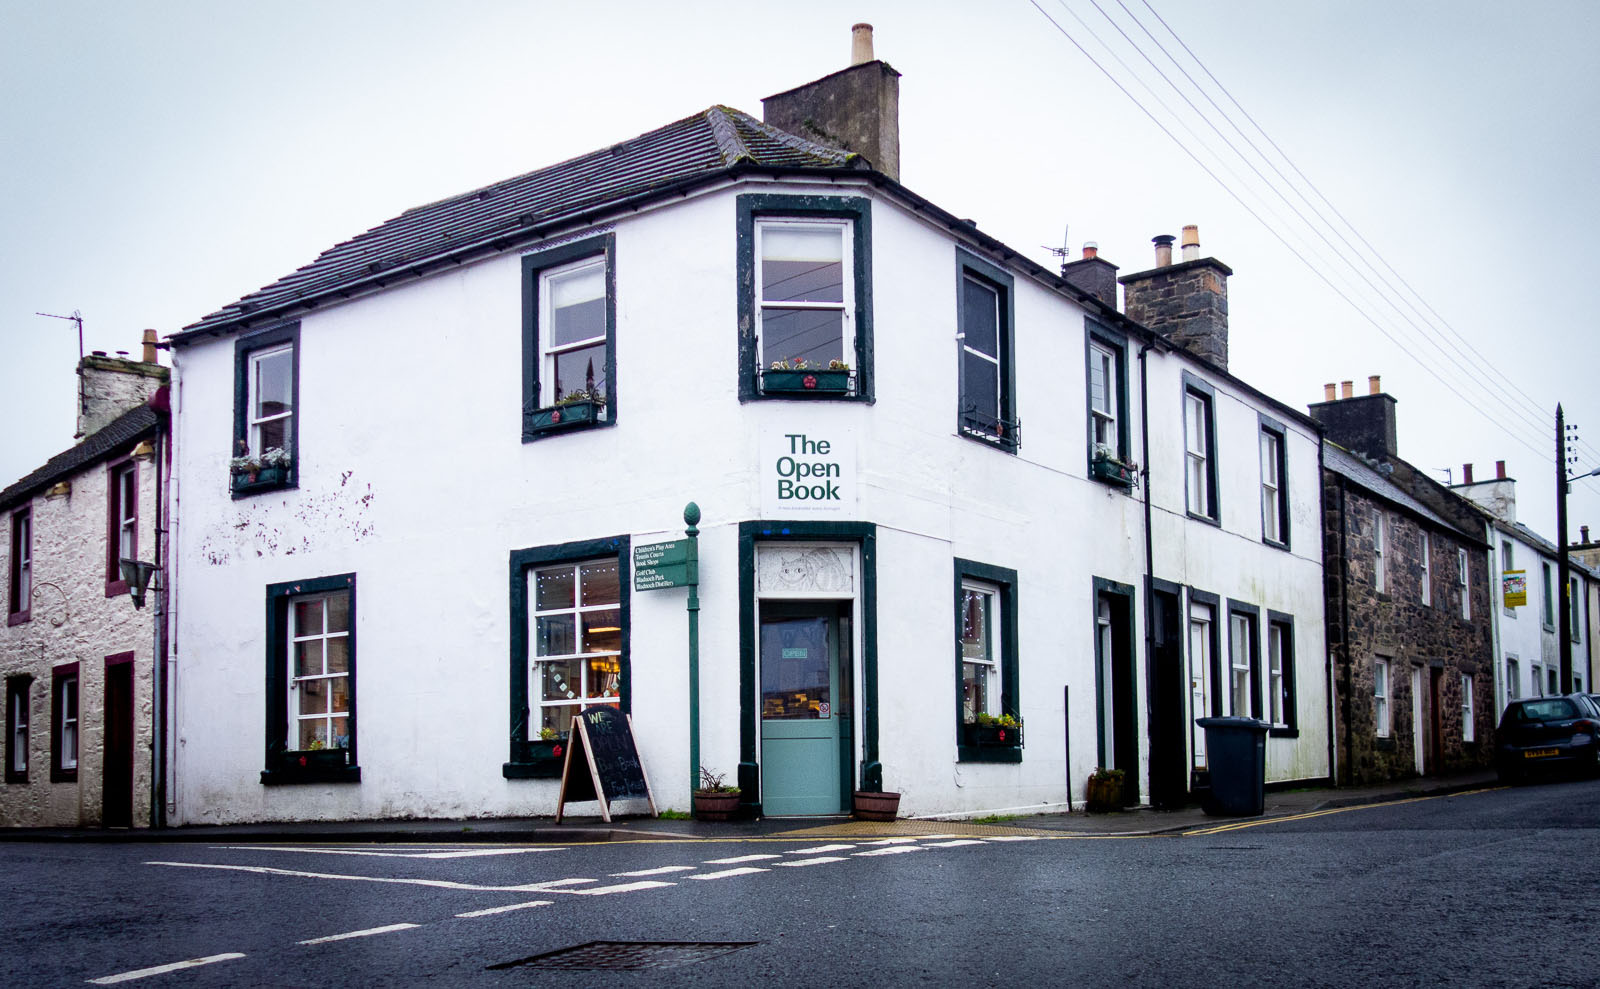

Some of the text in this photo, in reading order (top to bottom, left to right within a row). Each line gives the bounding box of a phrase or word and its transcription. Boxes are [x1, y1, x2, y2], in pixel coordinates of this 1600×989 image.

[785, 434, 831, 455] The
[776, 456, 840, 482] Open
[778, 479, 840, 500] Book
[588, 711, 605, 724] WE
